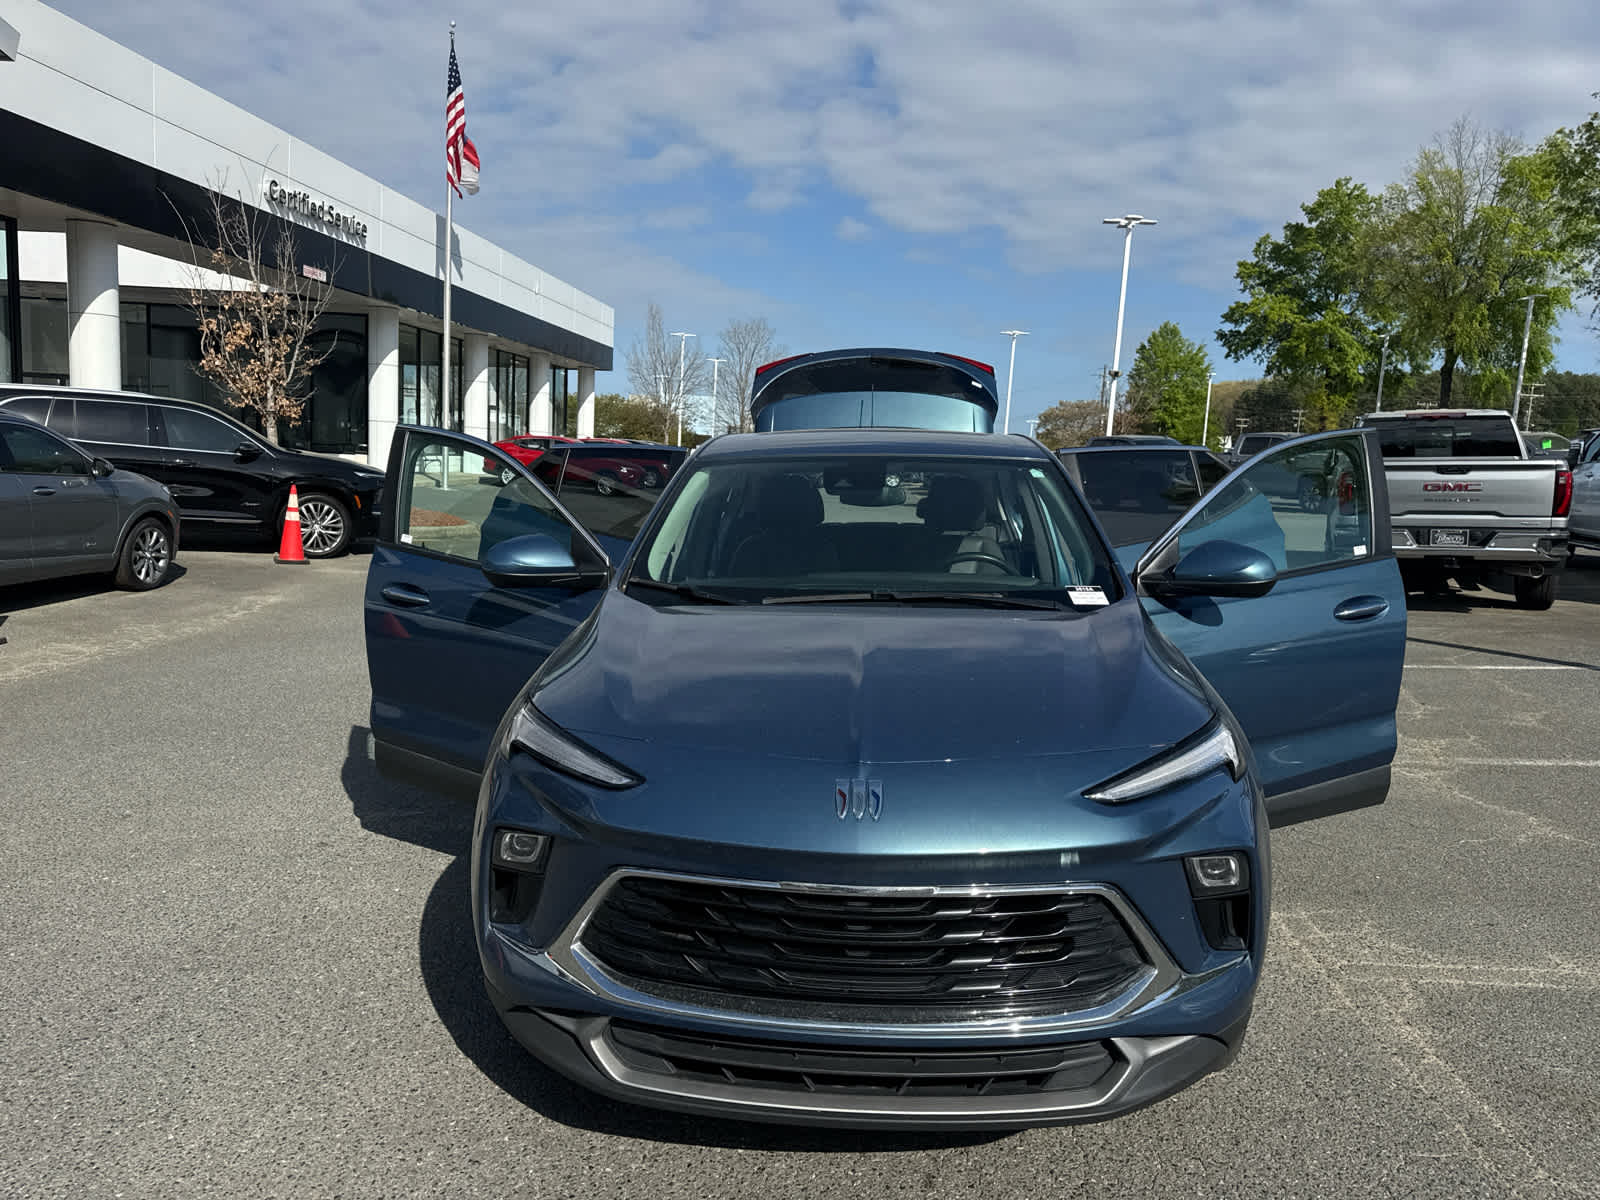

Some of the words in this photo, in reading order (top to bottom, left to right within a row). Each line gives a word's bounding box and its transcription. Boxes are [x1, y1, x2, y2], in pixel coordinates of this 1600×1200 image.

[268, 180, 325, 221] Certified
[326, 205, 367, 238] Service
[1423, 481, 1482, 492] GMC
